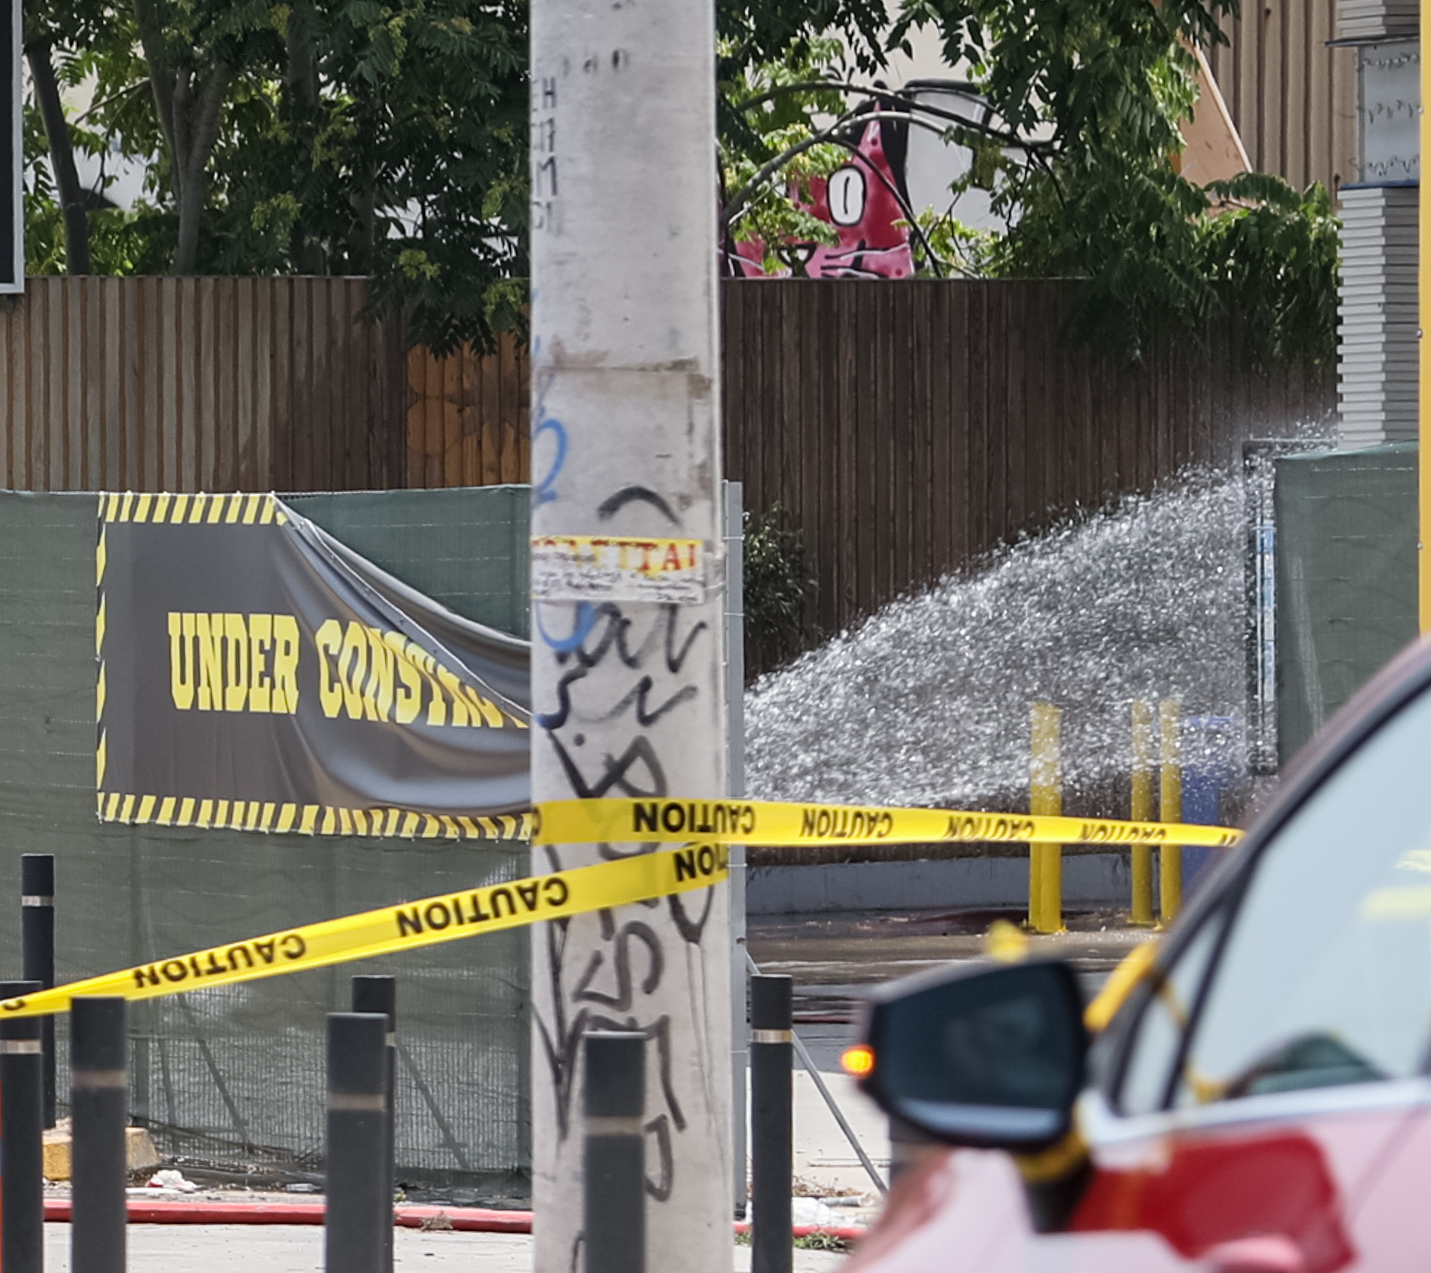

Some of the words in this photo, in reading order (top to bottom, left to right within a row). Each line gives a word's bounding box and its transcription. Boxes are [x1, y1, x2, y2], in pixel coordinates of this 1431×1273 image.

[167, 611, 301, 716] UNDER
[631, 801, 756, 835] CAUTION
[798, 808, 894, 839] CAUTION
[395, 875, 570, 938] CAUTION
[132, 933, 307, 989] CAUTION
